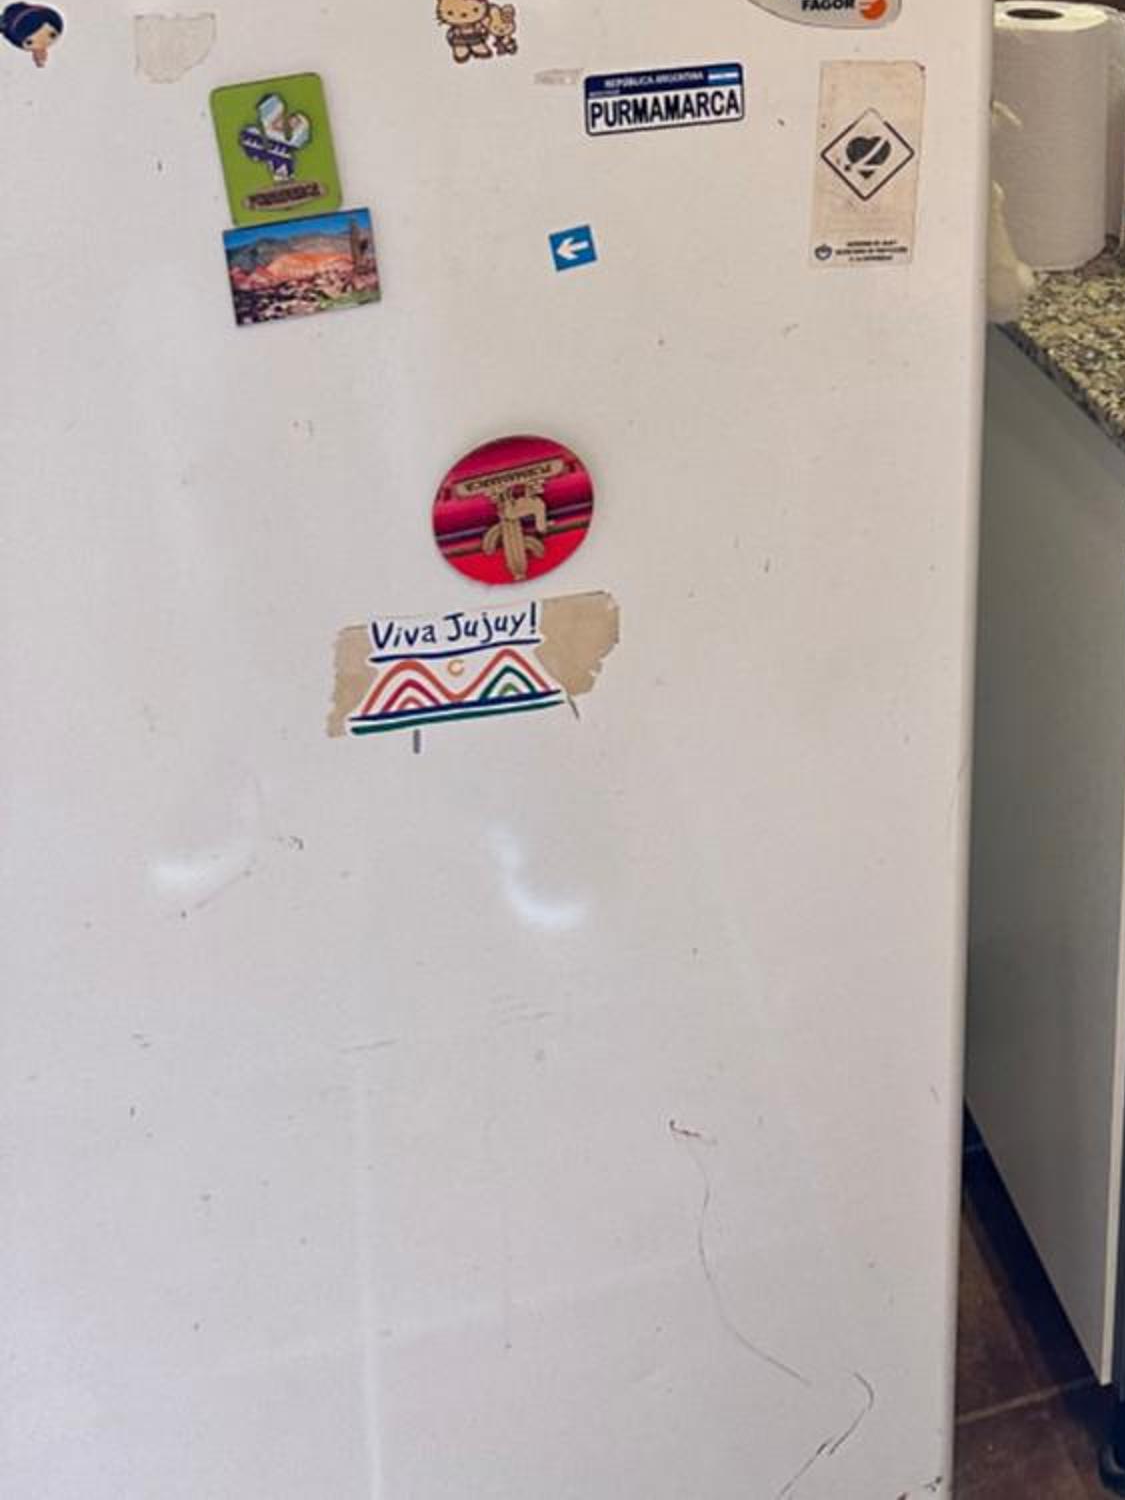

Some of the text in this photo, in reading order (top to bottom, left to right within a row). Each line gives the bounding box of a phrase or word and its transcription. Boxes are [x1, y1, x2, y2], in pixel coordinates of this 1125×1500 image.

[590, 89, 740, 129] PURMAMARCA
[371, 601, 537, 649] Viva Jujuy!
